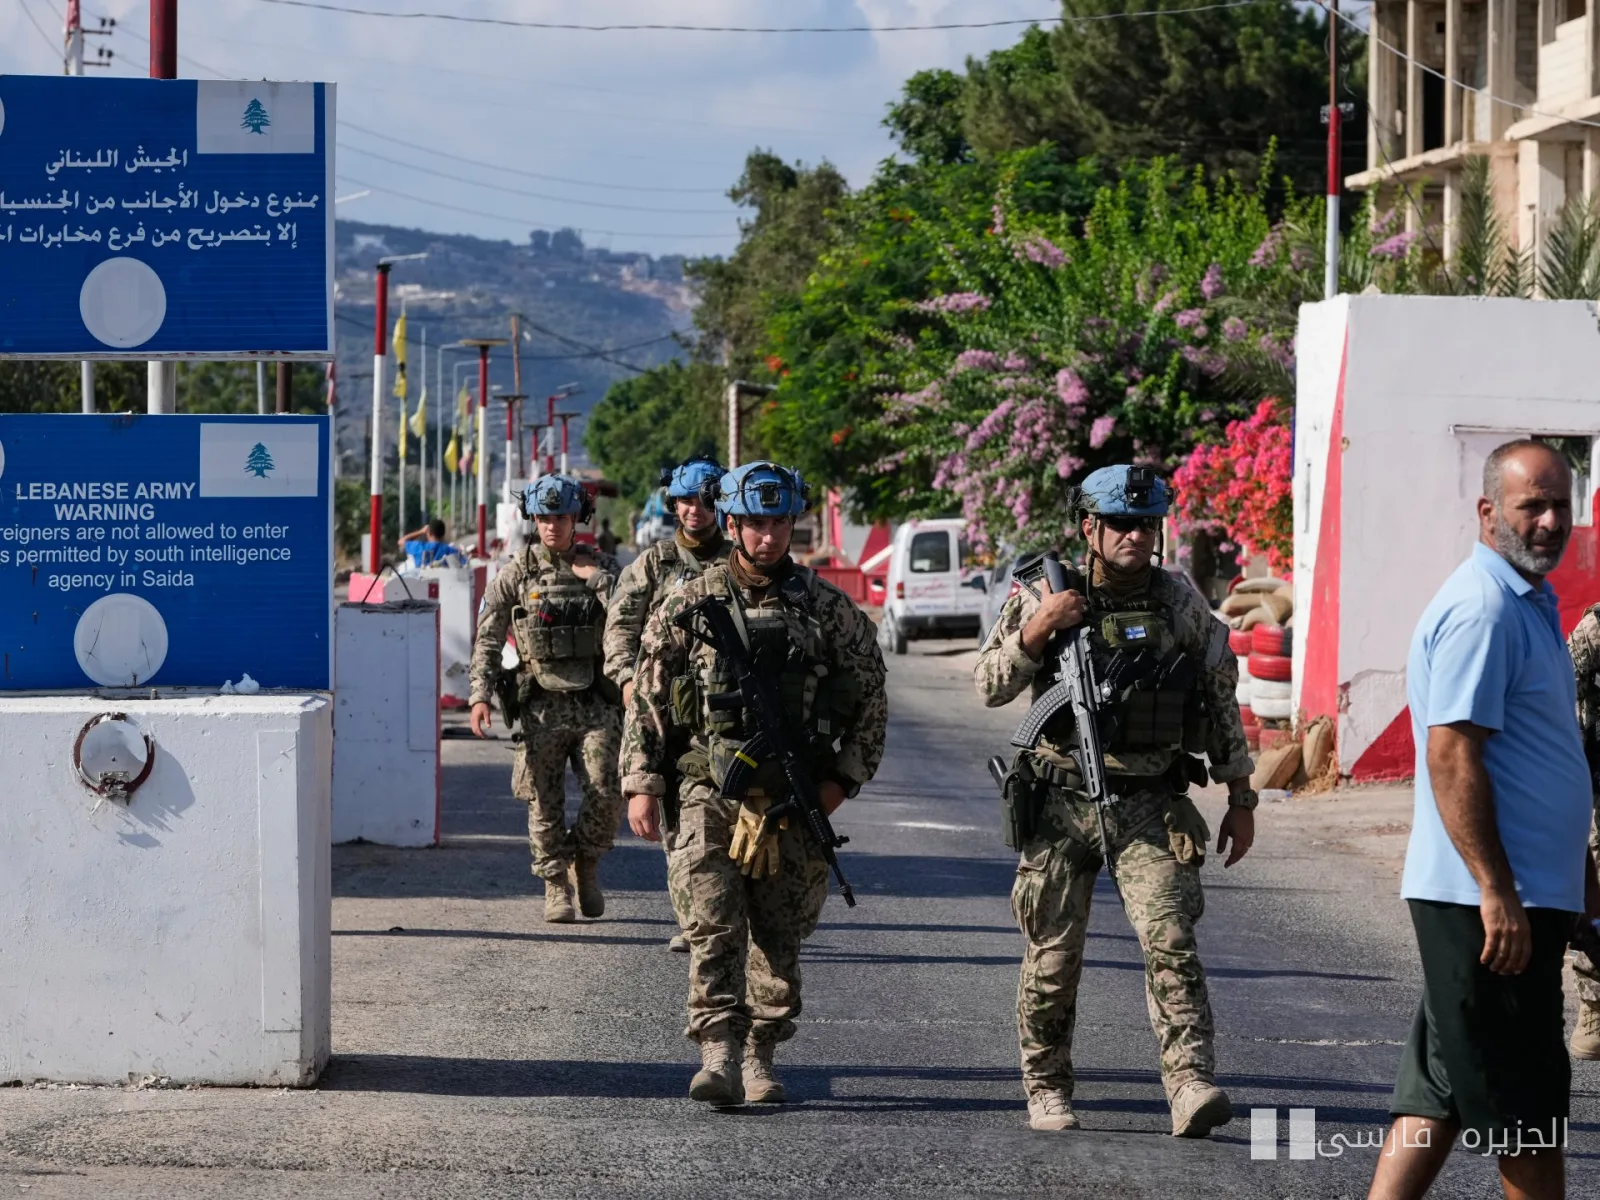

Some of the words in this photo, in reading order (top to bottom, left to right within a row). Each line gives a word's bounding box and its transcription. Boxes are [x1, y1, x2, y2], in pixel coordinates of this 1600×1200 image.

[46, 149, 119, 182] اللبناني
[125, 145, 188, 174] الجيش
[86, 195, 116, 215] من
[121, 182, 199, 215] الأجانب
[205, 190, 260, 214] دخول
[267, 192, 319, 217] ممنوع
[19, 223, 102, 249] مخابرات
[107, 221, 146, 251] فرع
[151, 228, 181, 248] من
[187, 225, 271, 250] بتصريح
[277, 222, 298, 250] إلا
[16, 482, 129, 500] LEBANESE
[134, 482, 196, 500] ARMY
[54, 503, 155, 521] WARNING
[76, 526, 106, 541] are
[112, 524, 140, 541] not
[145, 522, 214, 540] allowed
[220, 523, 237, 540] to
[242, 523, 289, 540] enter
[16, 545, 101, 567] permitted
[107, 545, 129, 567] by
[134, 545, 184, 563] south
[190, 544, 291, 566] intelligence
[48, 574, 115, 592] agency
[121, 571, 136, 588] in
[142, 569, 194, 588] Saida
